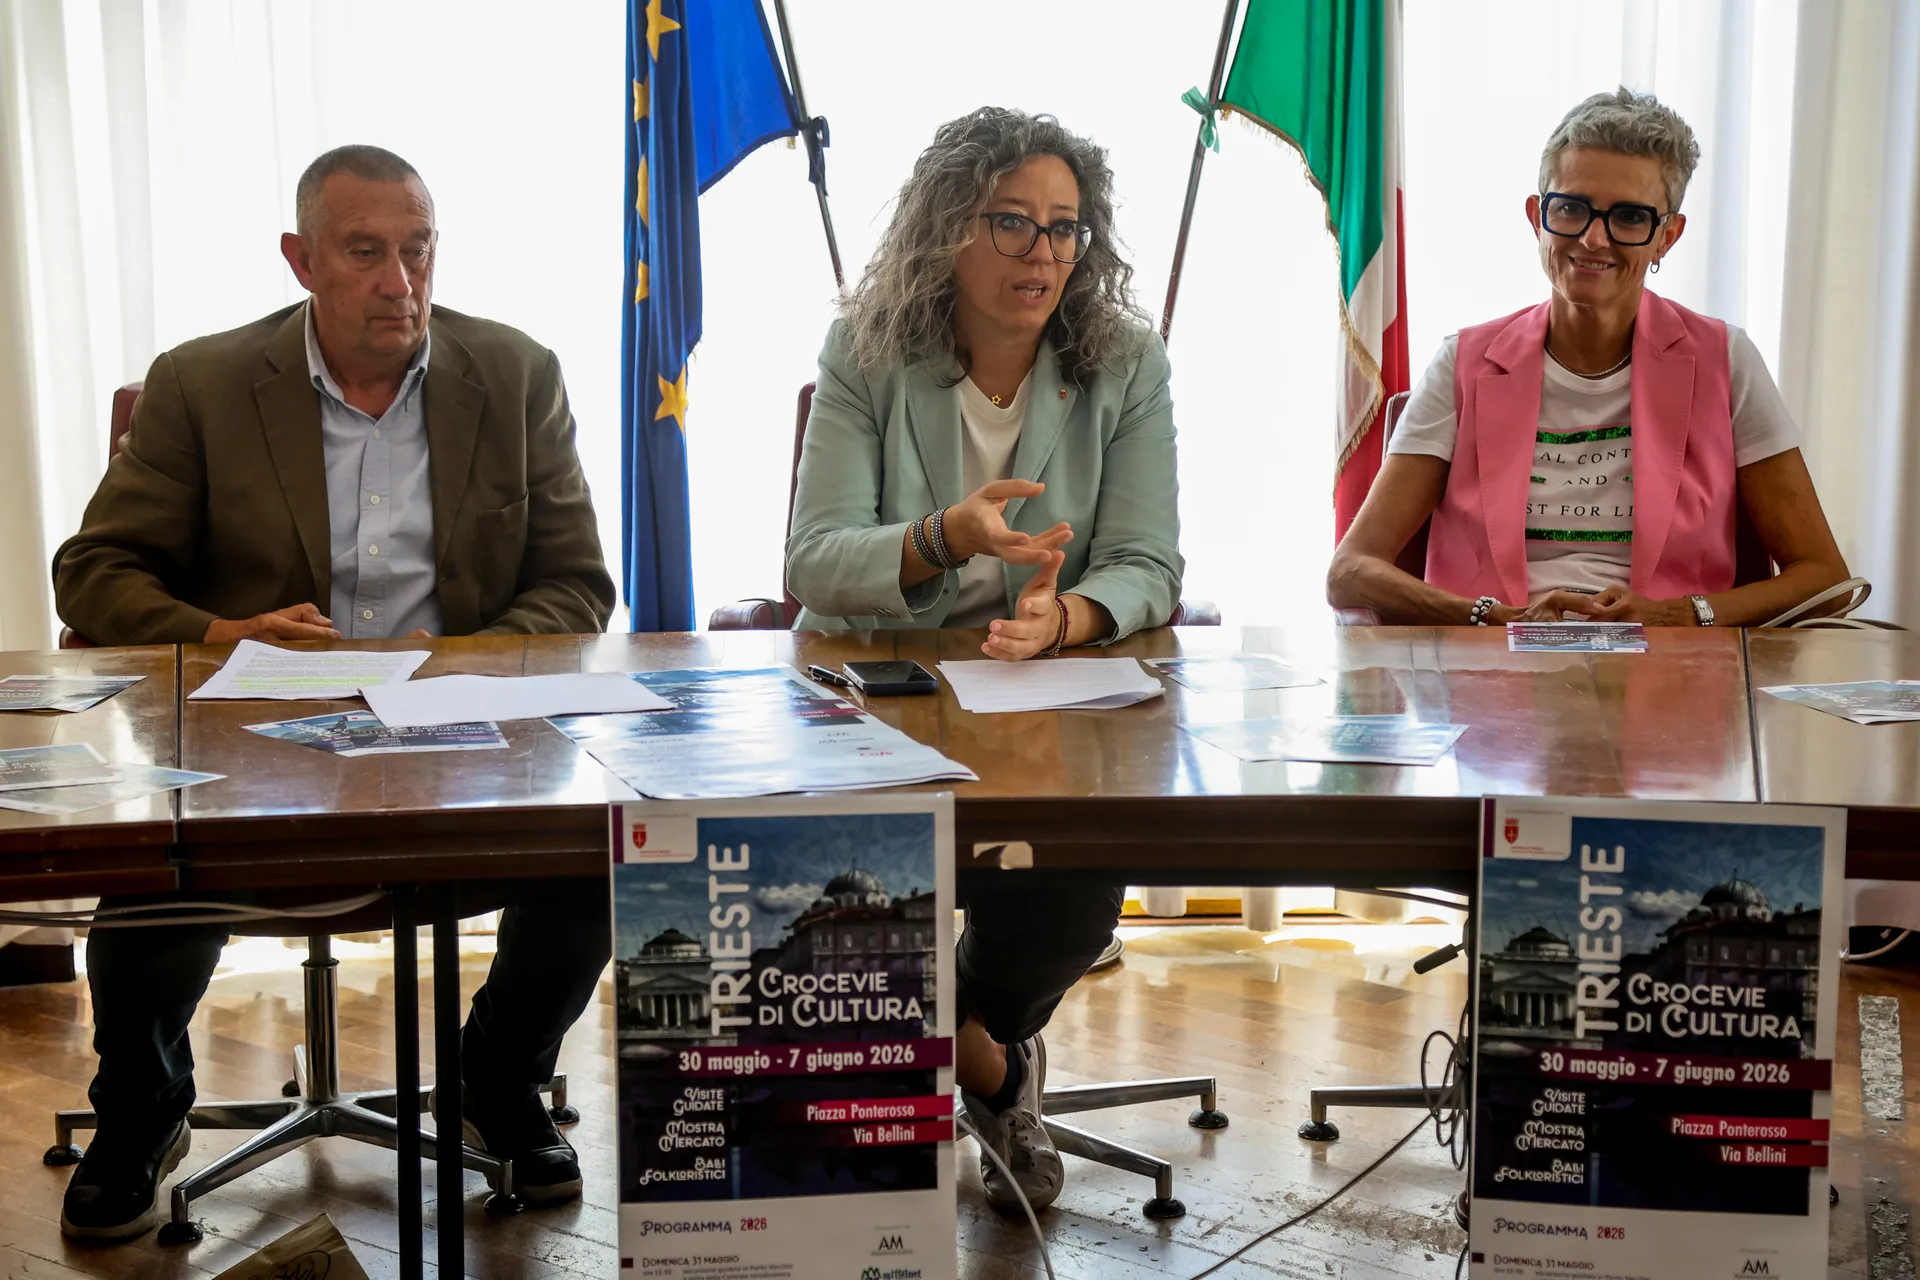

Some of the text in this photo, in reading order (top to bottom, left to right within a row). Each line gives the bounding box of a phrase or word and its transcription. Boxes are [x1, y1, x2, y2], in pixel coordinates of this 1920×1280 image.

[1563, 475, 1608, 486] AND
[1560, 505, 1601, 516] FOR
[708, 843, 752, 1036] TRIESTE
[1577, 844, 1625, 1039] TRIESTE
[759, 967, 889, 998] CROCEVIE
[1627, 972, 1766, 1008] CROCEVIE
[759, 994, 923, 1028] DI CULTURA
[1626, 1005, 1801, 1039] DI CULTURA
[679, 1052, 702, 1072] 30
[708, 1050, 770, 1074] maggio
[789, 1049, 800, 1068] 7
[806, 1048, 864, 1072] giugno
[870, 1045, 915, 1065] 2026
[1540, 1052, 1563, 1072] 30
[1570, 1056, 1636, 1080] maggio
[1656, 1058, 1668, 1078] 7
[1674, 1061, 1735, 1085] giugno
[1742, 1063, 1790, 1083] 2026
[684, 1087, 724, 1101] VISITE
[1545, 1088, 1586, 1103] VISITE
[673, 1098, 724, 1116] GUIDATE
[807, 1103, 915, 1121] Piazza Ponterosso
[1533, 1099, 1585, 1116] GUIDATE
[854, 1126, 915, 1144] Via Bellini
[1672, 1118, 1787, 1138] Piazza Ponterosso
[1721, 1146, 1786, 1164] Via Bellini
[640, 1218, 767, 1237] PROGRAMMA 2026
[1493, 1217, 1625, 1240] PROGRAMMA 2026
[879, 1235, 904, 1250] AM
[642, 1255, 740, 1269] DOMENICA 31 MAGGIO
[1494, 1254, 1594, 1270] DOMENICA 31 MAGGIO
[1743, 1260, 1769, 1274] AM
